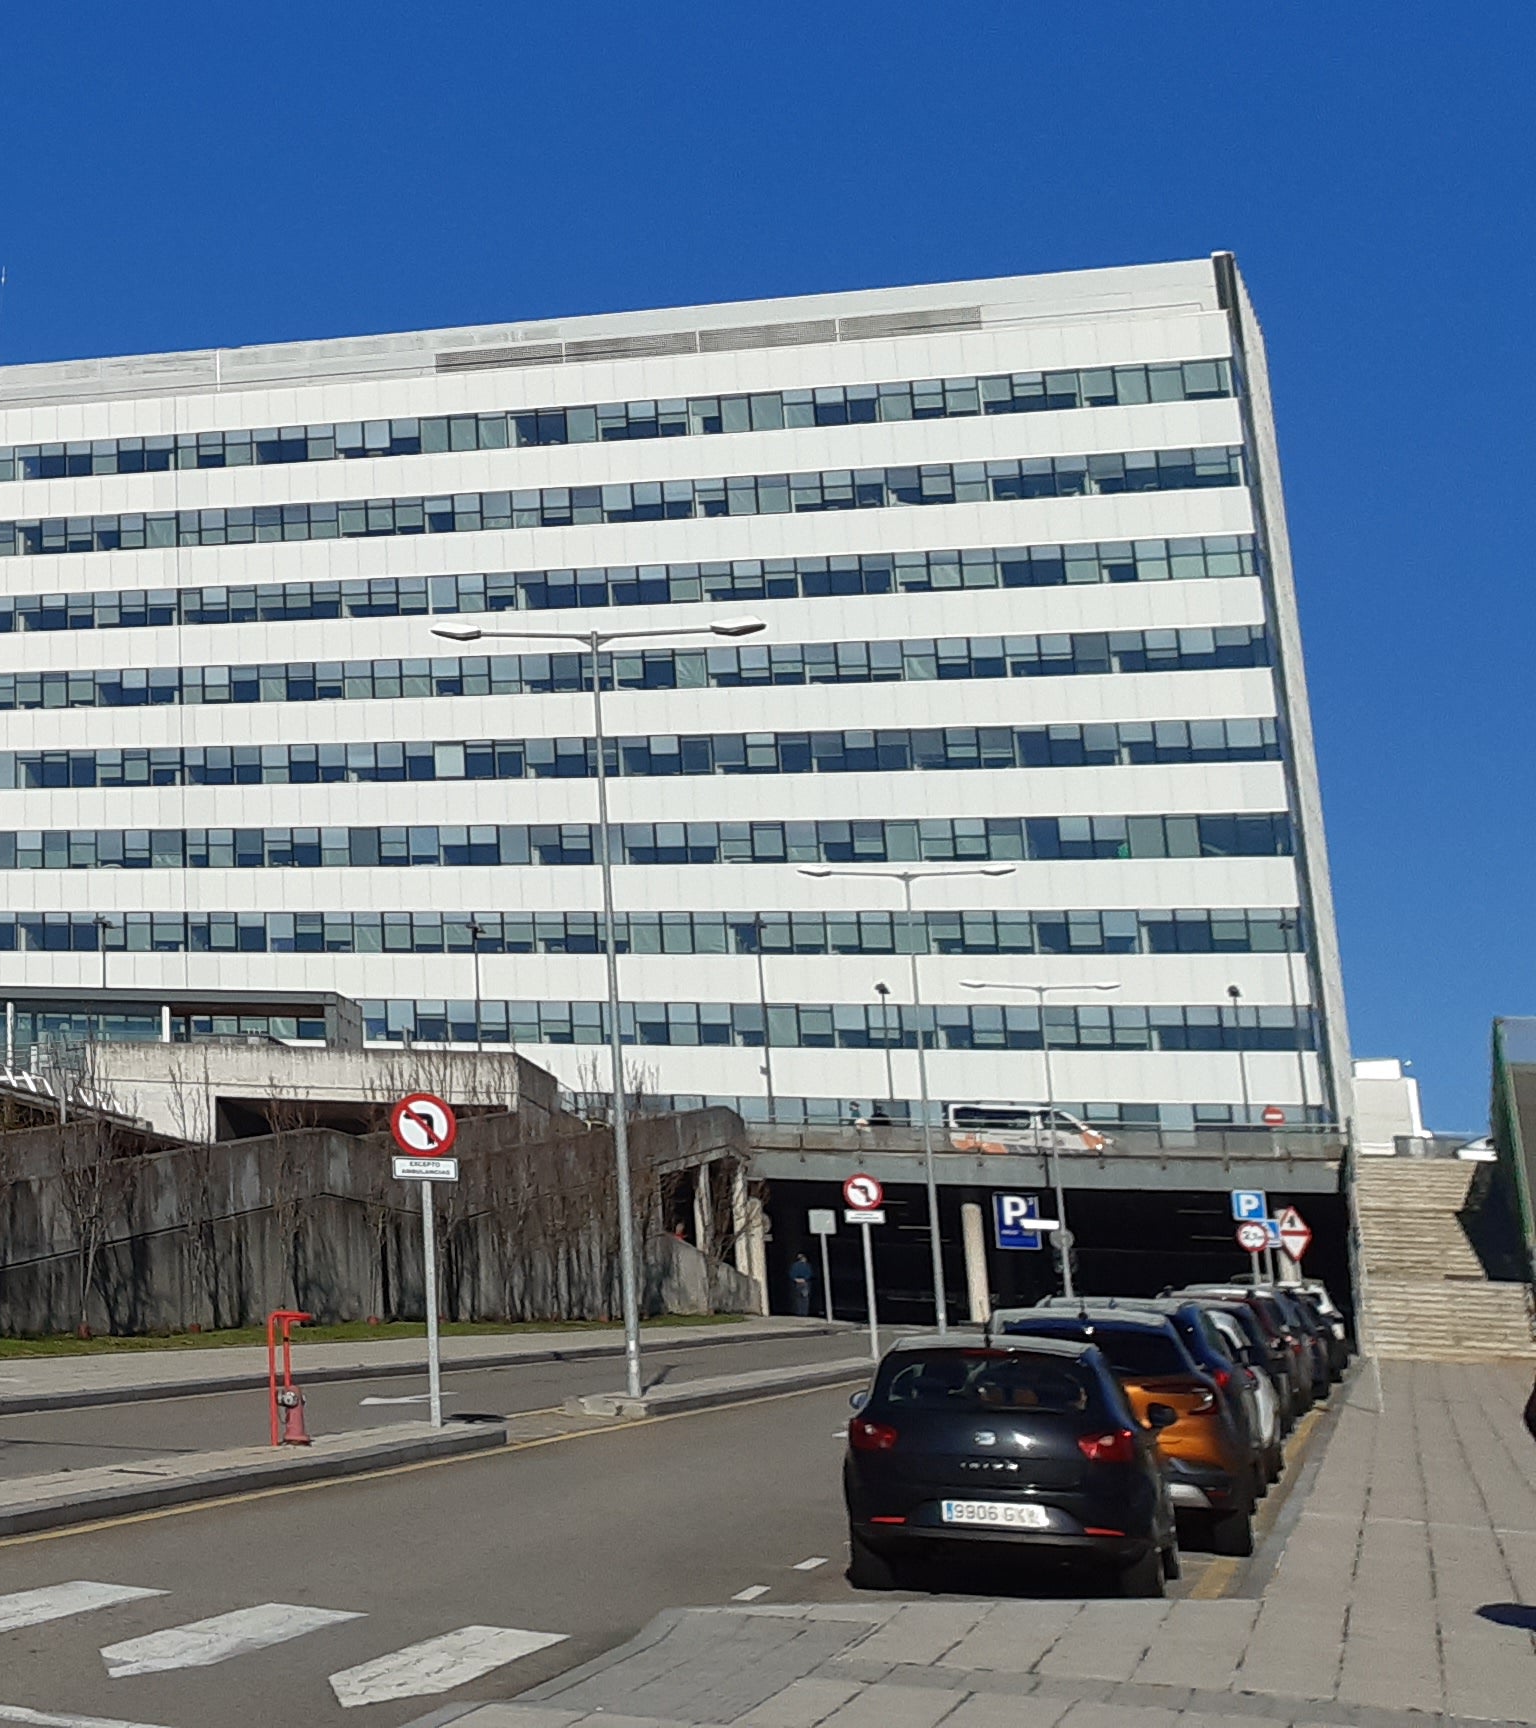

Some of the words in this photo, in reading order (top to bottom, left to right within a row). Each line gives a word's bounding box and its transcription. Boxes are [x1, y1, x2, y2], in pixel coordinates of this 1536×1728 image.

[1003, 1196, 1027, 1226] P
[1239, 1194, 1260, 1217] P
[954, 1503, 999, 1521] 9906
